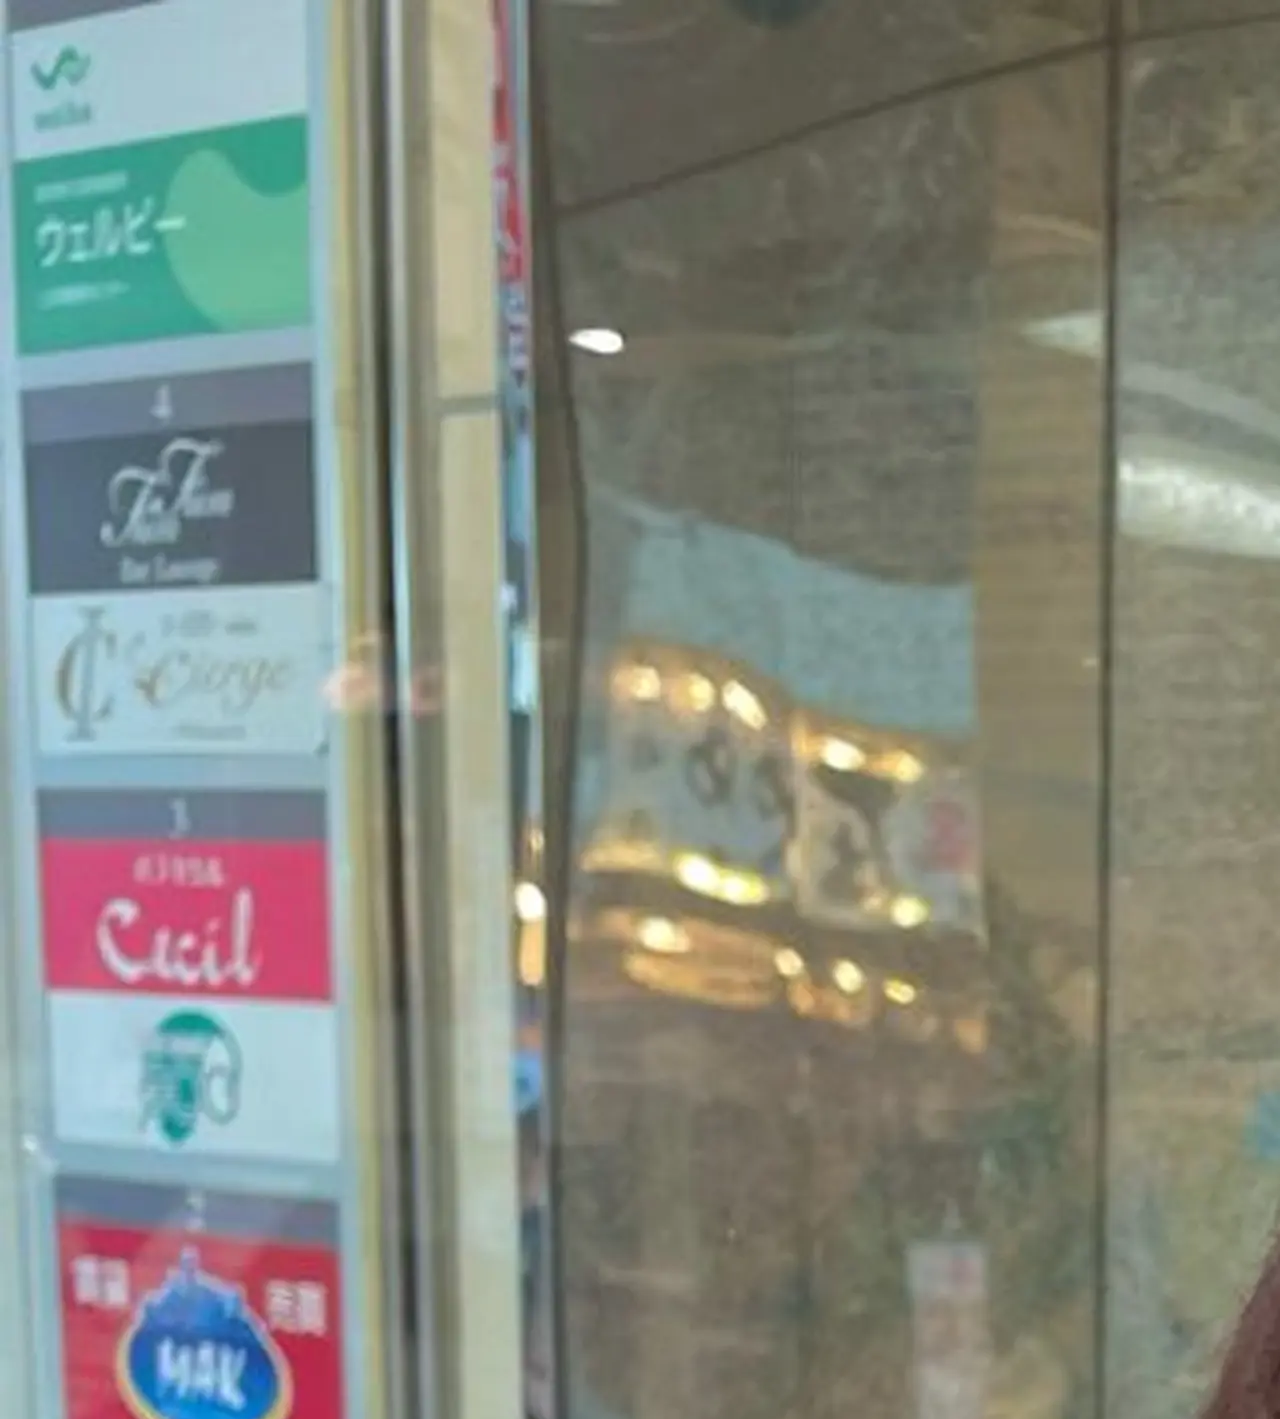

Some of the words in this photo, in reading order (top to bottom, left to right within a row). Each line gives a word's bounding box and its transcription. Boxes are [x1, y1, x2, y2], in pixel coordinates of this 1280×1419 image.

[36, 197, 186, 267] ウェルビー
[97, 884, 264, 986] Cecil
